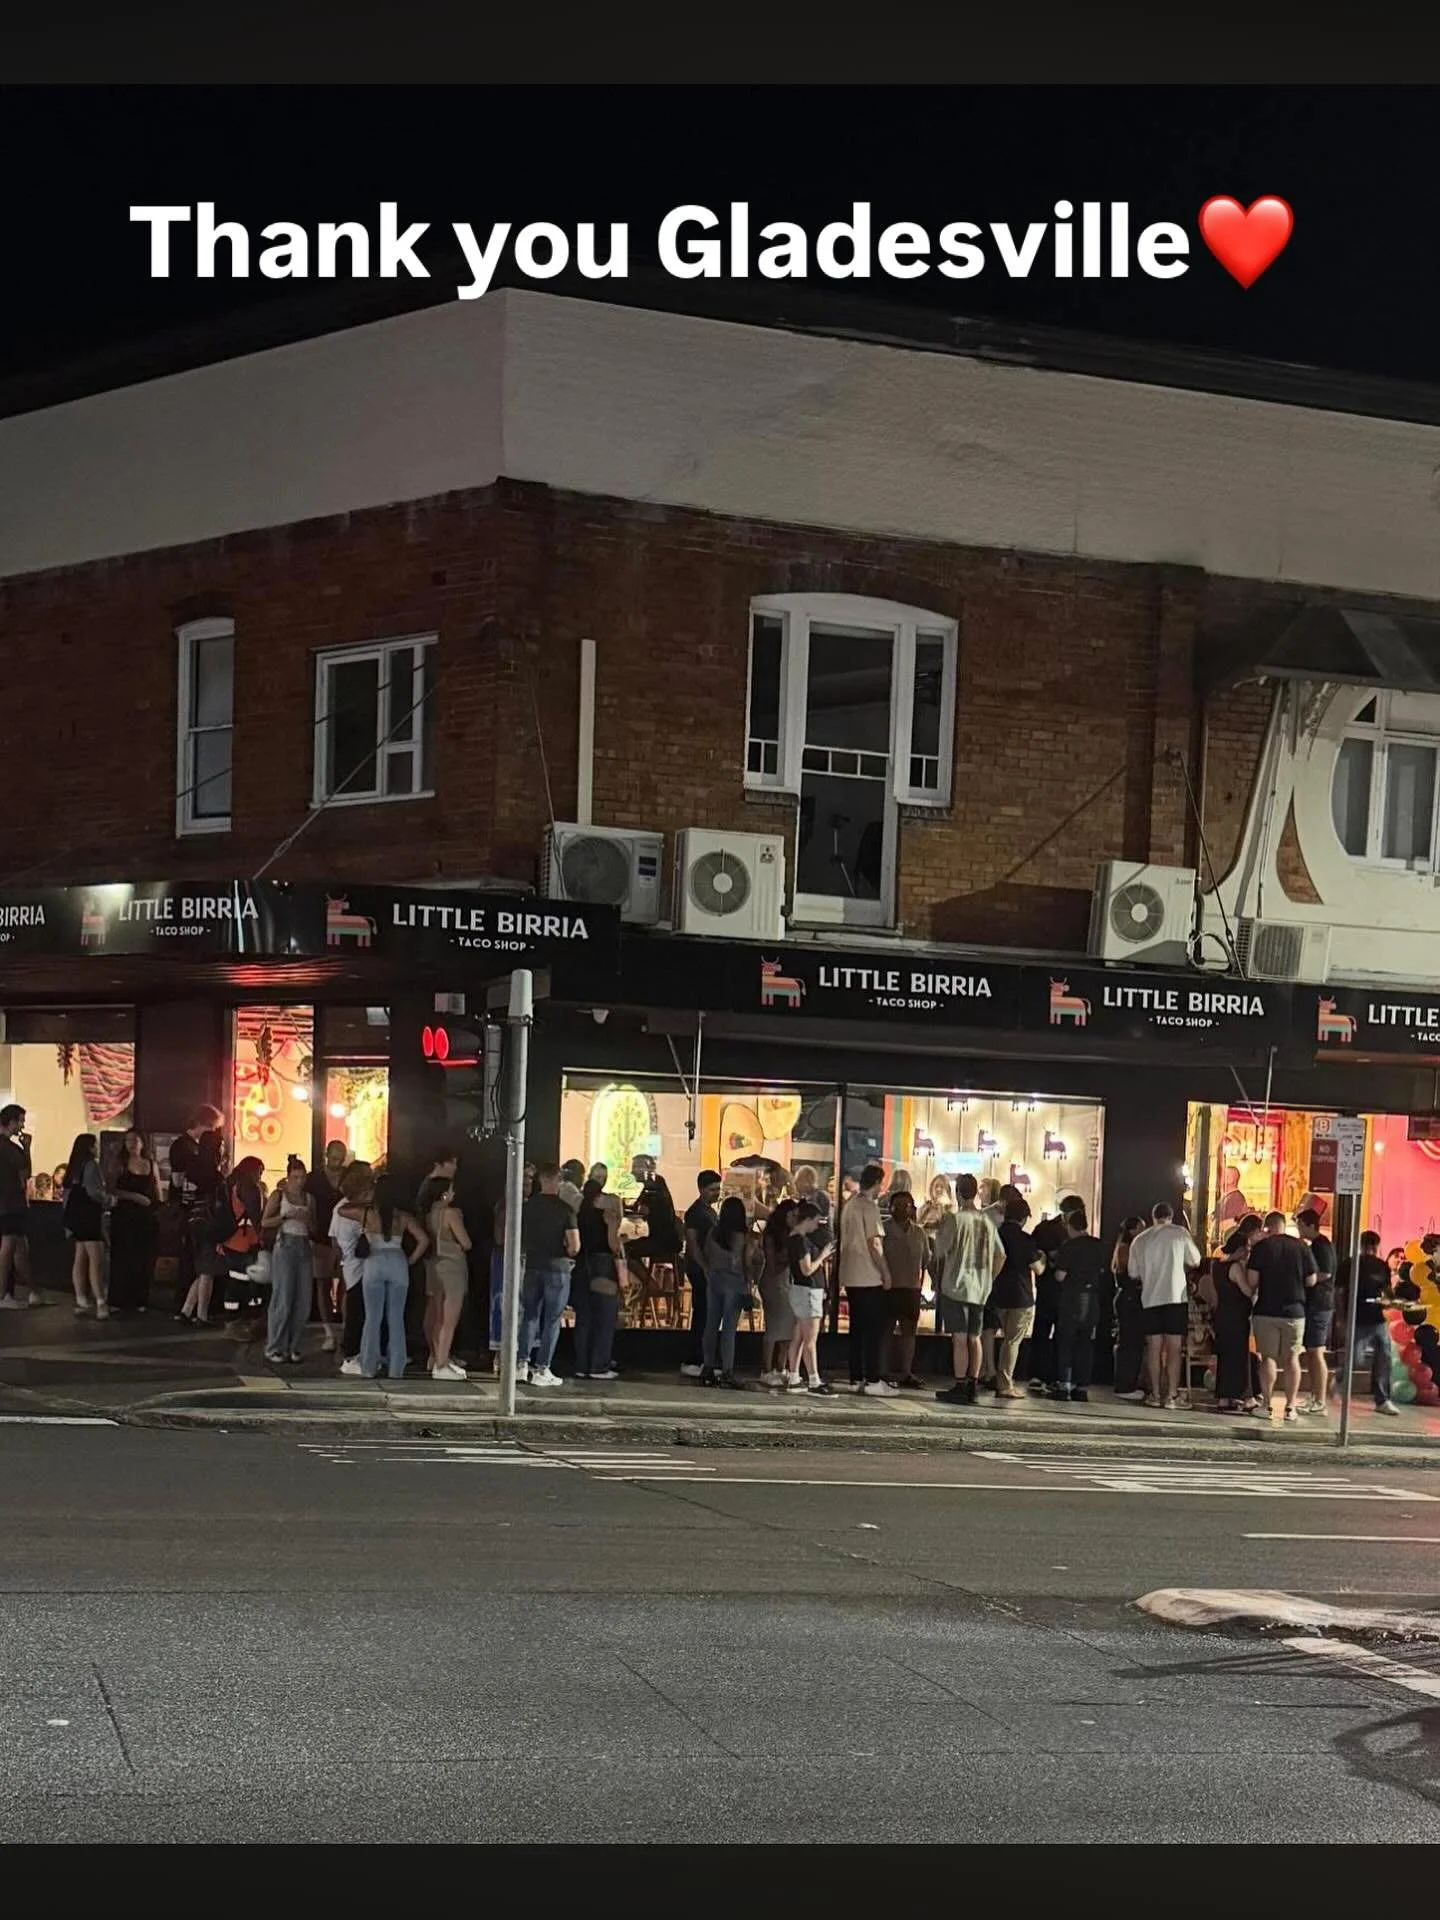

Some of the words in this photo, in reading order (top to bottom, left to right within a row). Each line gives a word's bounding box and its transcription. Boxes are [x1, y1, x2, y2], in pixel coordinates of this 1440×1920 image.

[118, 897, 174, 921] LITTLE
[181, 897, 260, 920] BIRRIA
[155, 926, 178, 936] TACO
[179, 926, 204, 936] SHOP
[393, 903, 485, 932] LITTLE
[496, 911, 589, 940] BIRRIA
[0, 932, 11, 943] OP
[458, 936, 492, 949] TACO
[494, 939, 527, 951] SHOP
[818, 966, 900, 992] LITTLE
[910, 972, 992, 998] BIRRIA
[876, 996, 906, 1008] TACO
[908, 998, 937, 1009] SHOP
[1103, 986, 1179, 1011] LITTLE
[1188, 992, 1265, 1017] BIRRIA
[1155, 1016, 1184, 1026] TACO
[1185, 1017, 1213, 1028] SHOP
[1368, 1003, 1440, 1028] LITTLE
